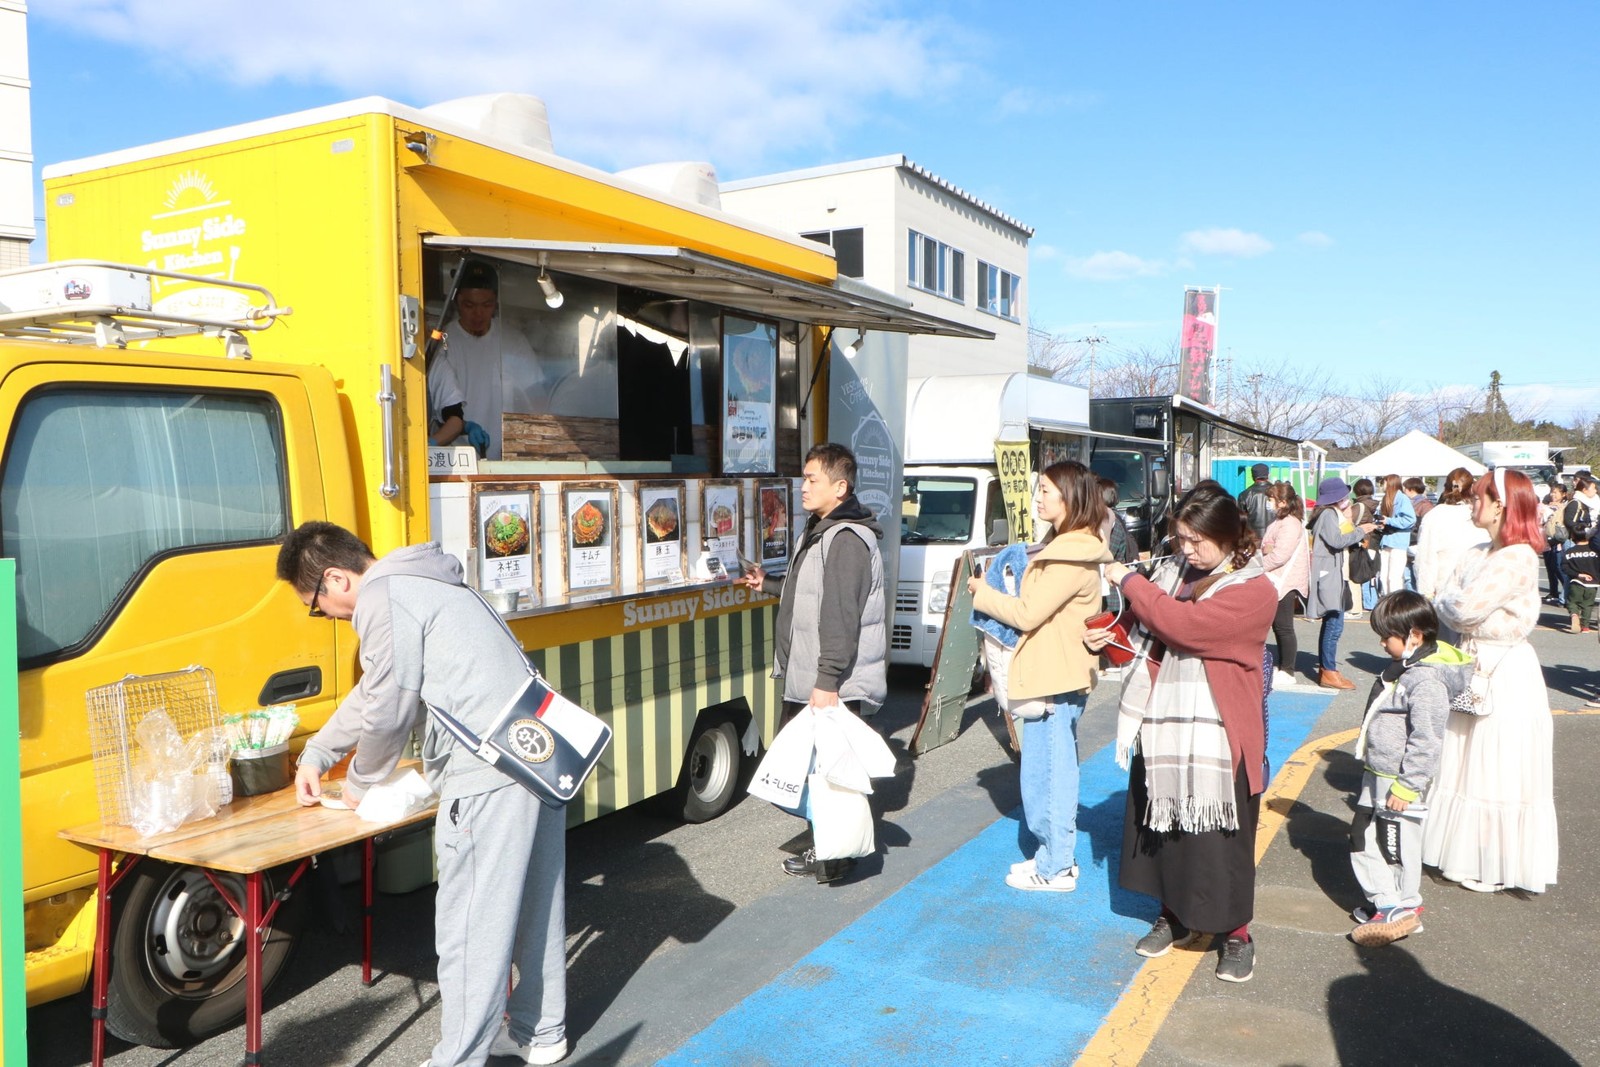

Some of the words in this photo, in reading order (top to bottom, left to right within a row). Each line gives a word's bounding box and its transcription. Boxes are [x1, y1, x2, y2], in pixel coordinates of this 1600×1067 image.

[142, 227, 202, 252] Sunny
[203, 214, 246, 240] Side
[164, 249, 223, 271] Kitchen
[497, 559, 520, 573] ネギ玉
[581, 550, 600, 560] キムチ
[623, 595, 700, 627] Sunny
[703, 585, 746, 612] Side
